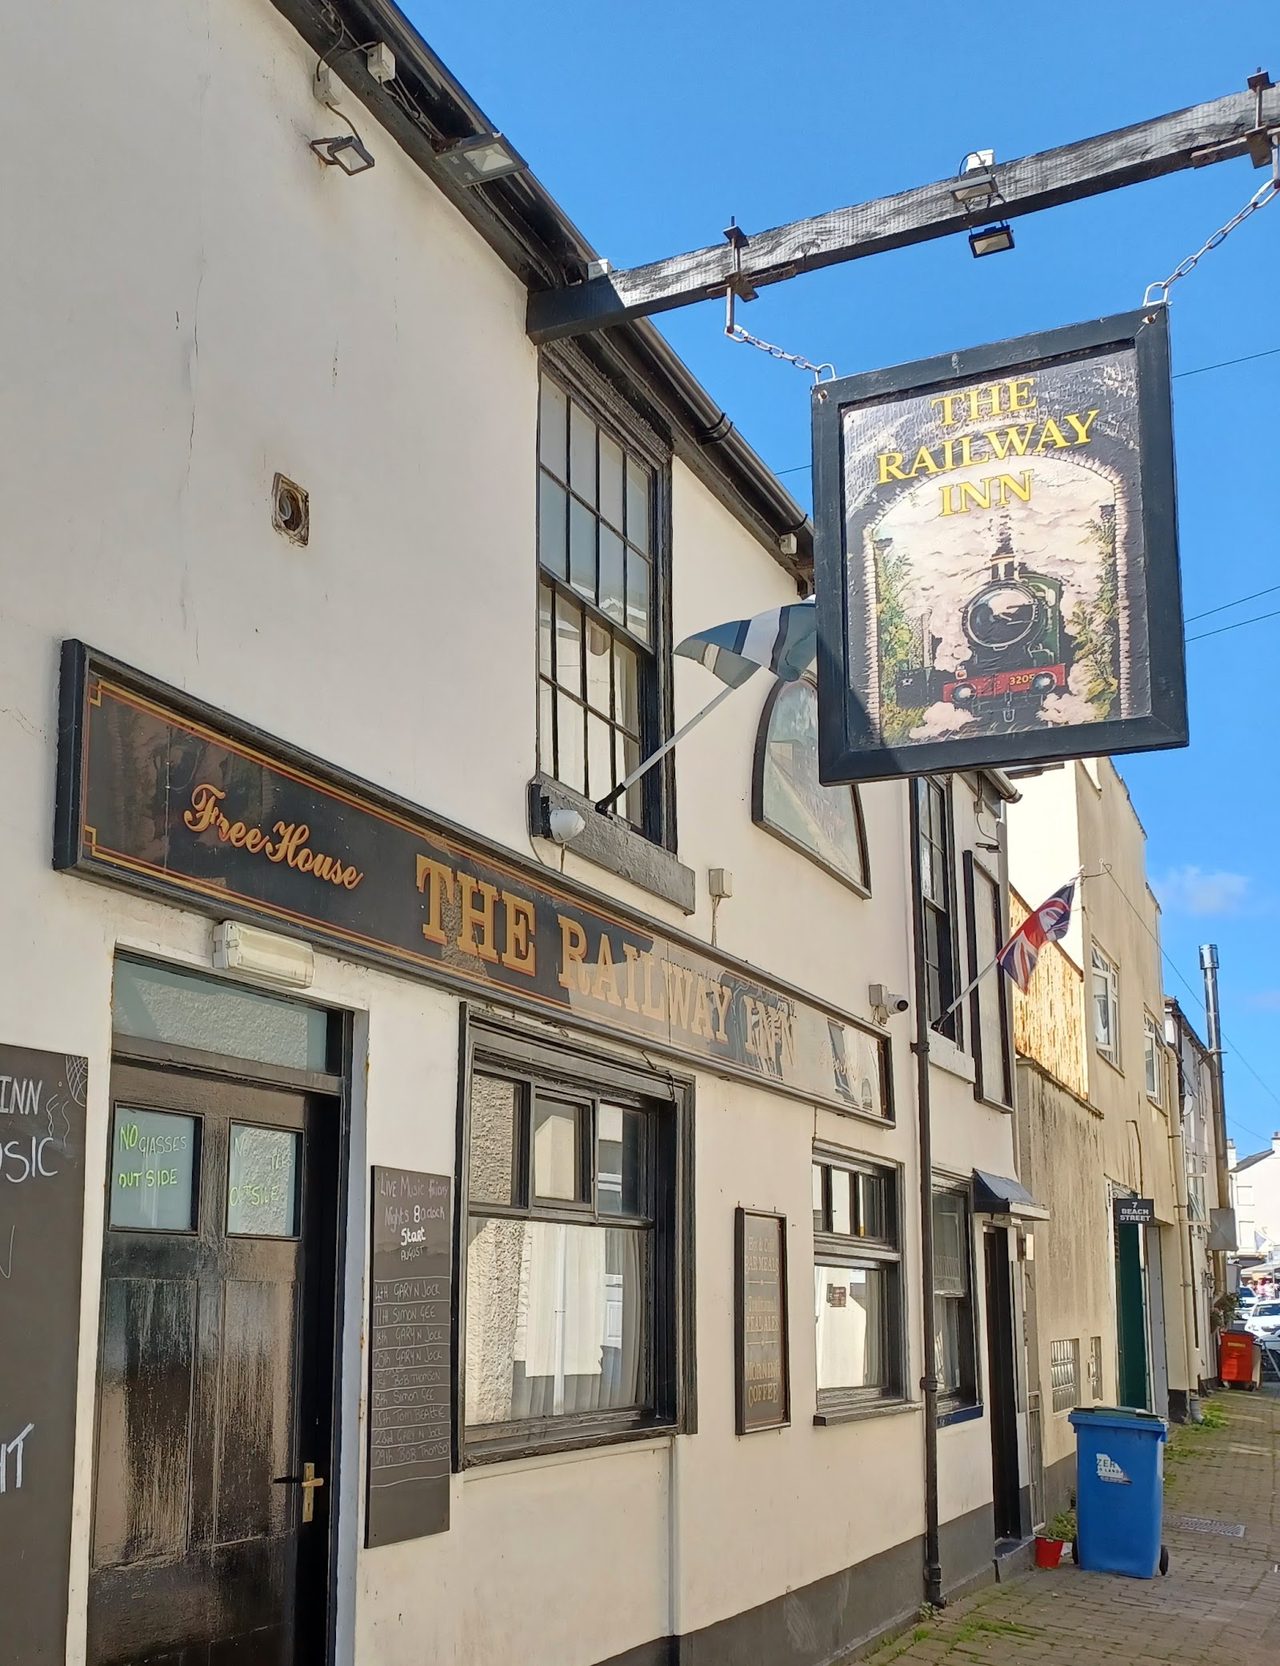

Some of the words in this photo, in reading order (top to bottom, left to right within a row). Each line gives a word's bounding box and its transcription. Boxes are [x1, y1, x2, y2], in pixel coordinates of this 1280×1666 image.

[931, 377, 1037, 428] THE
[877, 409, 1098, 485] RAILWAY
[939, 468, 1034, 517] INN
[183, 783, 269, 851] Free
[265, 820, 364, 891] House
[416, 853, 536, 977] THE
[557, 914, 732, 1046] RAILWAY
[0, 1075, 43, 1115] INN
[119, 1123, 138, 1153] NO
[0, 1136, 59, 1184] SIC
[145, 1169, 178, 1188] SIDE
[1120, 1214, 1151, 1222] STREET
[1131, 1201, 1138, 1209] 7
[400, 1226, 426, 1247] Start
[748, 1382, 778, 1409] COFFEE
